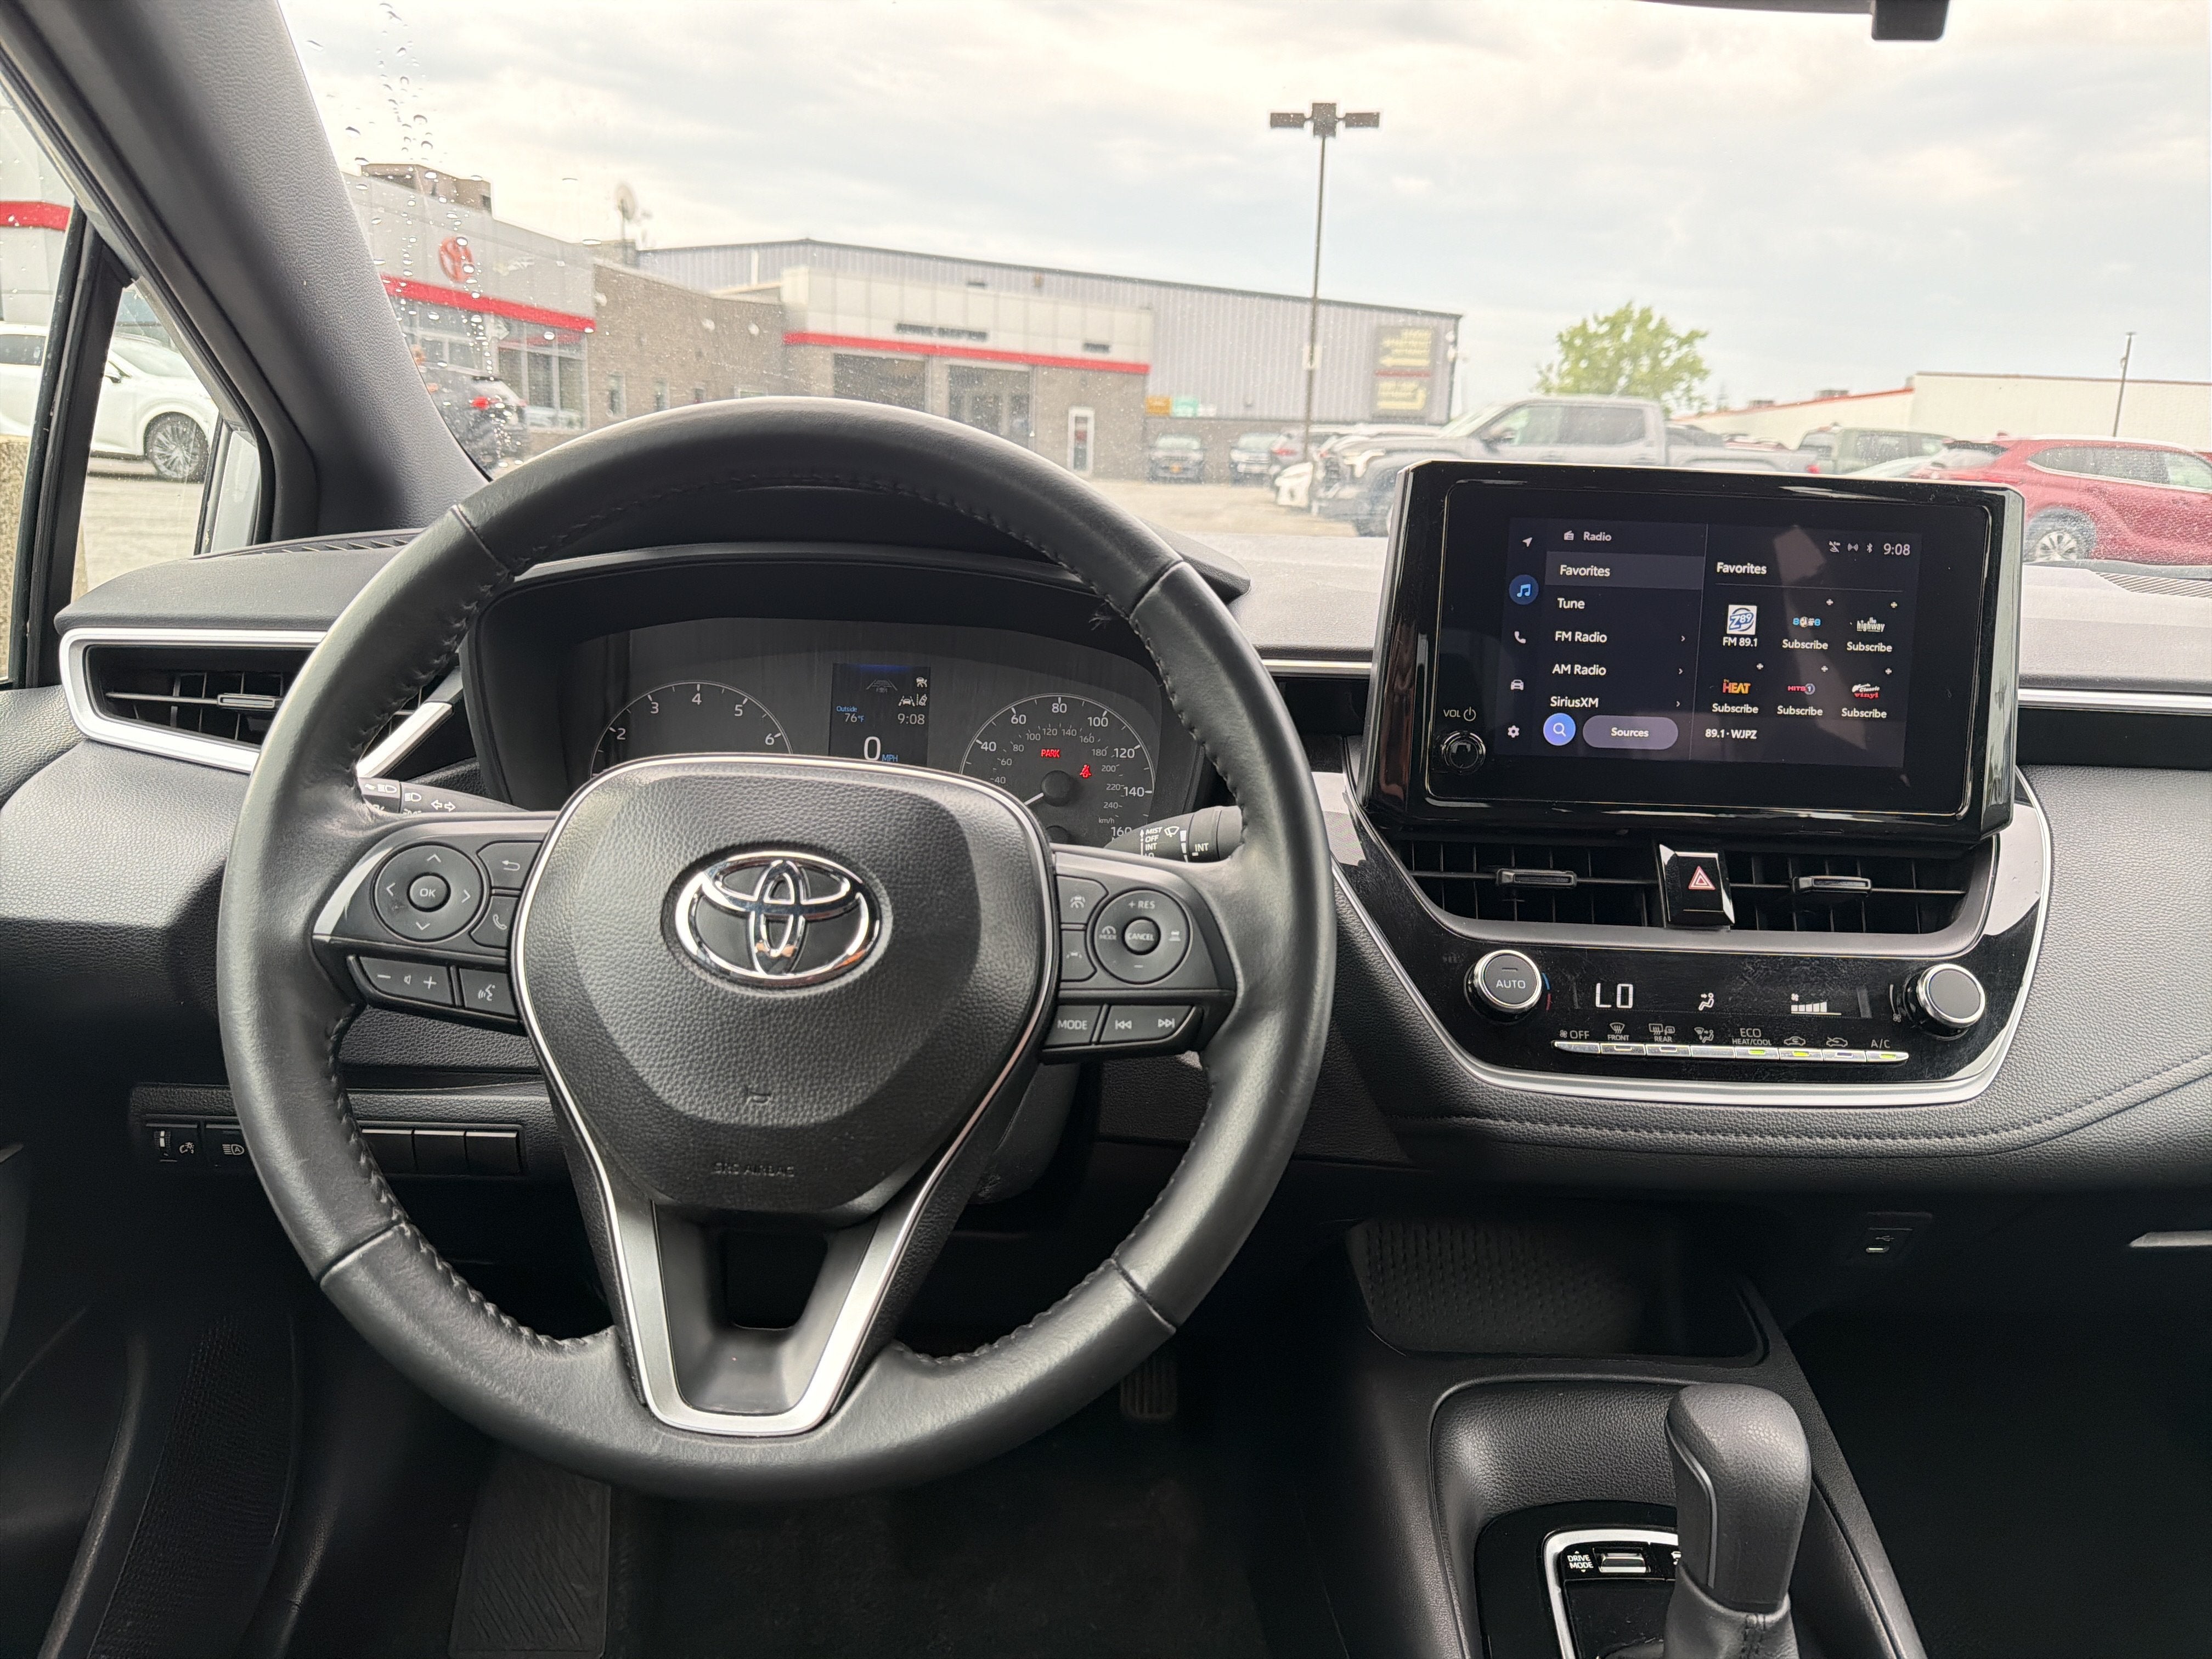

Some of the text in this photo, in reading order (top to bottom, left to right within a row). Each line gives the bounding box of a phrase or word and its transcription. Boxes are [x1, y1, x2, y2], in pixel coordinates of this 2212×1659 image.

[1583, 531, 1612, 541] Radio
[1883, 543, 1911, 556] 9:08
[1560, 565, 1611, 577] Favorites
[1716, 562, 1768, 575] Favorites
[1557, 597, 1585, 609] Tune
[1729, 612, 1754, 630] Z89
[1857, 620, 1886, 633] highway
[1555, 631, 1607, 643] FM Radio
[1723, 636, 1758, 647] FM 89.1
[1782, 639, 1829, 650] Subscribe
[1847, 641, 1893, 652] Subscribe
[1551, 664, 1607, 676] AM Radio
[1722, 682, 1751, 694] HEAT
[691, 693, 702, 706] 4
[1550, 696, 1599, 708] SiriusXM
[650, 702, 659, 714] 3
[734, 704, 743, 717] 5
[1052, 703, 1068, 713] 80
[1443, 709, 1461, 718] VOL
[1712, 703, 1759, 714] Subscribe
[1777, 705, 1823, 716] Subscribe
[1841, 707, 1887, 719] Subscribe
[898, 713, 925, 725] 9:08
[1011, 714, 1026, 725] 60
[1087, 716, 1109, 727] 100
[616, 727, 626, 740] 2
[1042, 728, 1058, 736] 120
[1611, 727, 1649, 737] Sources
[1705, 729, 1757, 740] 89.1 WJPZ
[765, 733, 775, 746] 6
[864, 736, 898, 762] 0 MPH
[980, 741, 996, 752] 40
[1013, 744, 1024, 752] 80
[1041, 748, 1060, 758] PARK
[1092, 748, 1107, 757] 180
[1113, 748, 1135, 759] 120
[1124, 787, 1144, 797] 140
[1145, 826, 1163, 836] MIST
[1145, 834, 1159, 843] OFF
[1145, 842, 1158, 851] INT
[1195, 843, 1209, 852] INT
[420, 888, 436, 898] OK
[1138, 900, 1155, 910] RES
[1127, 933, 1154, 941] CANCEL
[1496, 979, 1526, 990] AUTO
[1595, 983, 1634, 1008] LO
[1057, 1019, 1088, 1030] MODE
[1570, 1030, 1590, 1039] OFF
[1740, 1028, 1762, 1038] ECO
[1871, 1039, 1891, 1048] A/C
